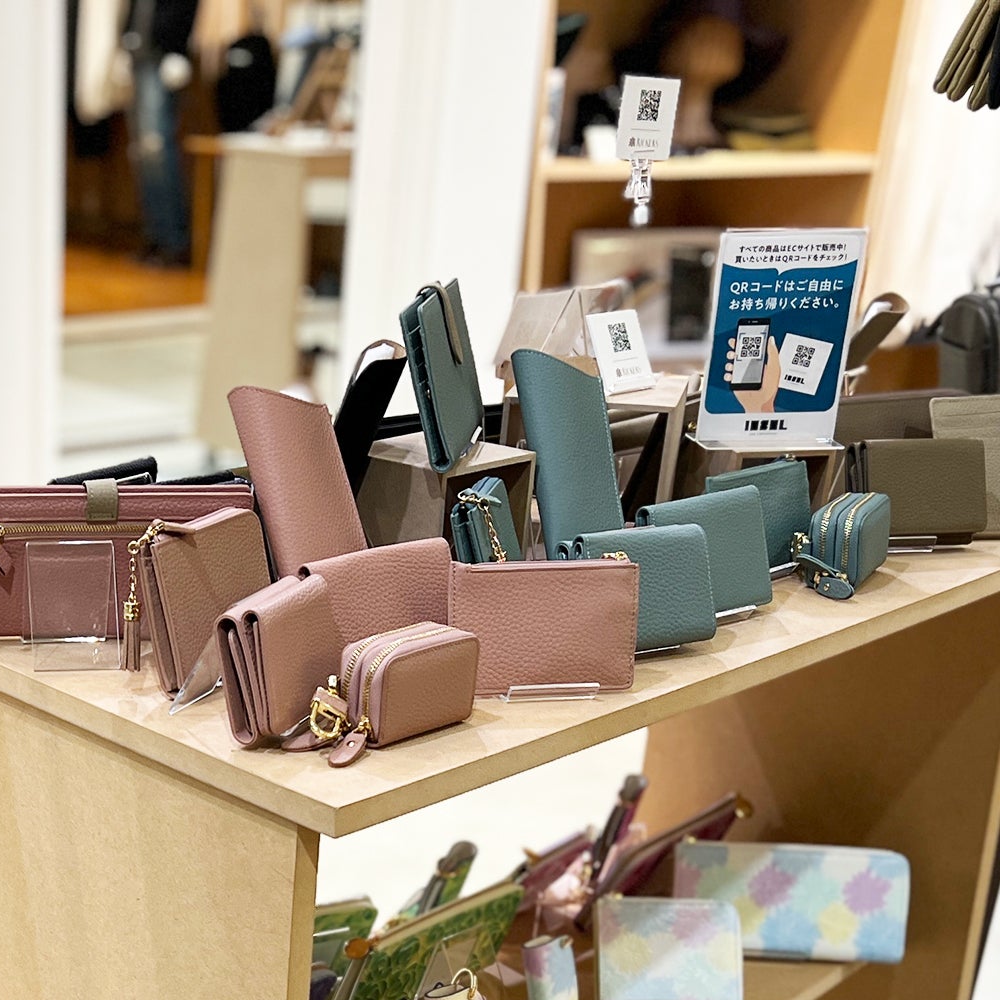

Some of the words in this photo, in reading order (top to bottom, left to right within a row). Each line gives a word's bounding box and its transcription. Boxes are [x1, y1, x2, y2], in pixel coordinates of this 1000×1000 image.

[729, 278, 844, 294] QRコードはご自由に
[728, 297, 840, 311] お持ち帰りください。
